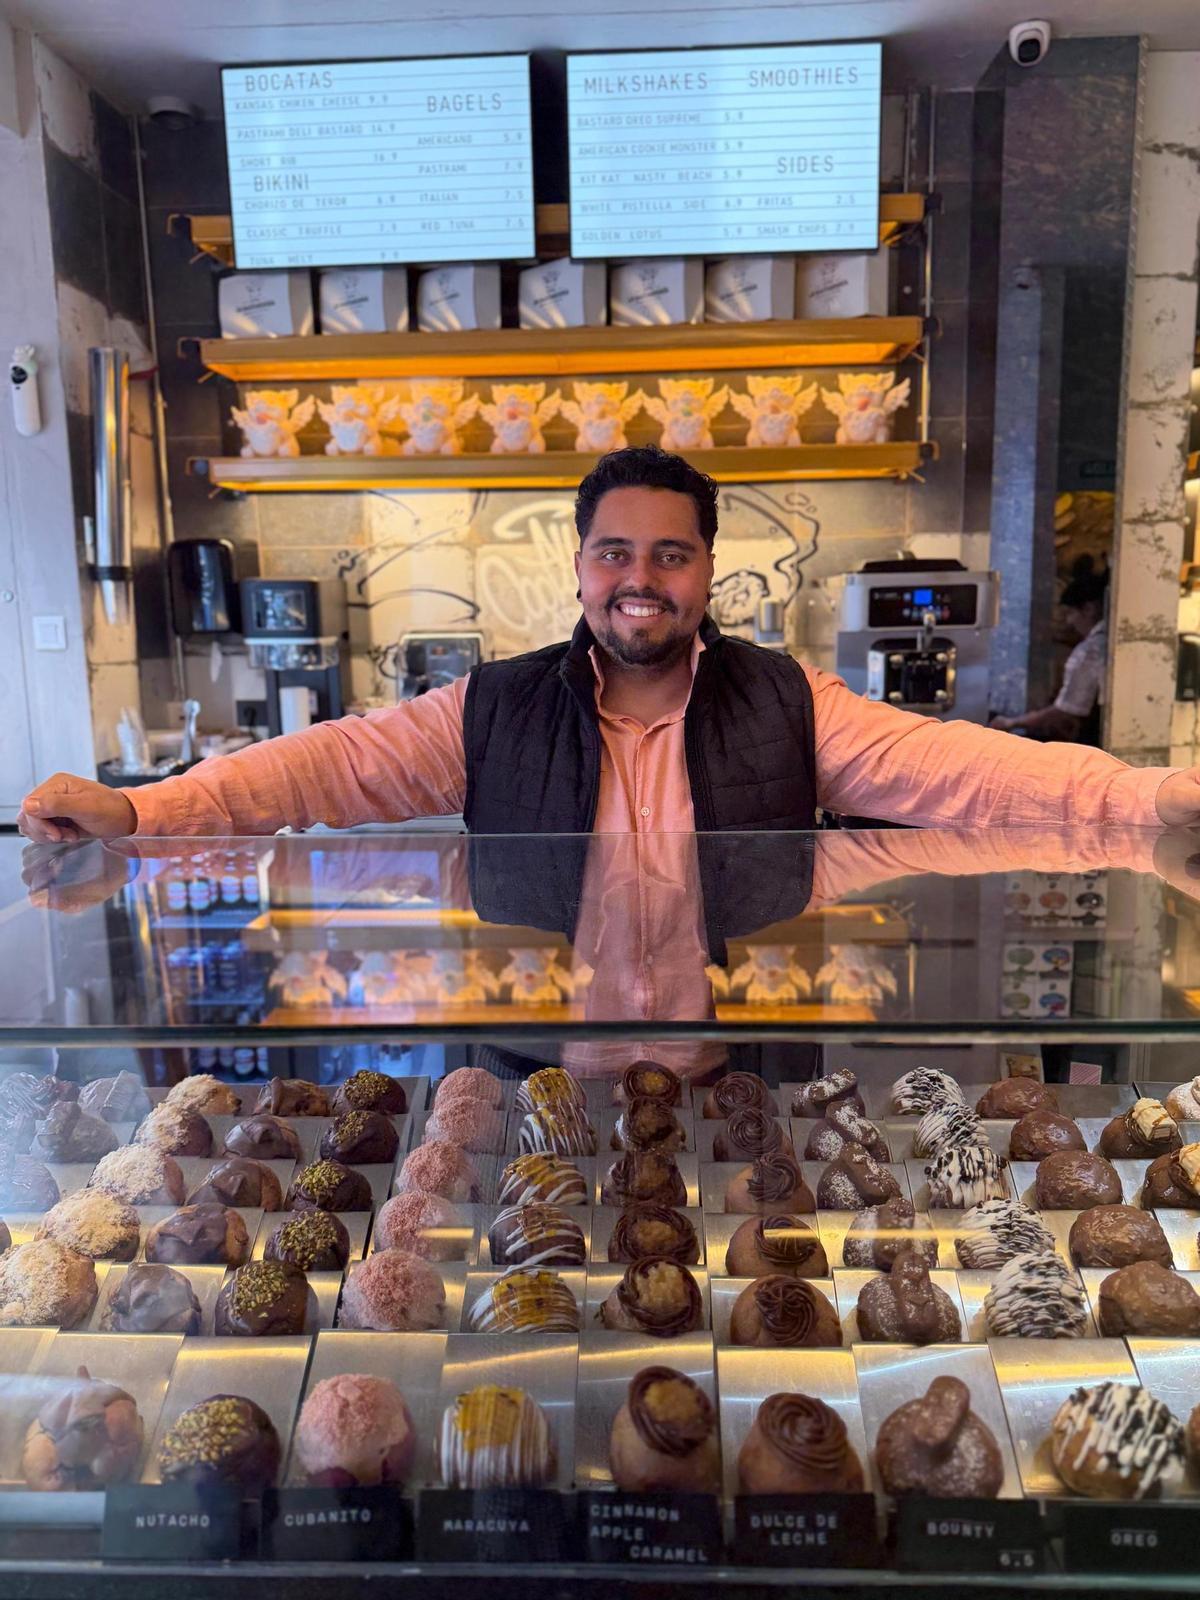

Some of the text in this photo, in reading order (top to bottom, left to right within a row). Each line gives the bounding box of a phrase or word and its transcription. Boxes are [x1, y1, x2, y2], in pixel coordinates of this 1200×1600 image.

[245, 71, 333, 92] BOCATAS
[584, 72, 708, 94] MILKSHAKES
[749, 66, 858, 87] SMOOTHIES
[235, 100, 274, 110] KANSAS
[322, 96, 360, 106] CHEESE
[427, 93, 502, 112] BAGELS
[577, 117, 623, 127] BASTARD
[626, 115, 652, 125] OREO
[656, 113, 701, 124] SUPREME
[238, 129, 285, 139] PASTRAMI
[289, 127, 312, 136] DELI
[318, 125, 363, 135] BASTARD
[418, 135, 472, 145] AMERICANO
[579, 144, 627, 155] AMERICAN
[631, 143, 665, 154] COOKIE
[670, 142, 716, 152] MONSTER
[240, 157, 271, 167] SHORT
[280, 156, 296, 165] RIB
[777, 155, 834, 174] SIDES
[418, 164, 467, 174] PASTRAMI
[254, 174, 309, 192] BIKINI
[580, 175, 596, 184] KIT
[602, 174, 620, 182] KAT
[634, 172, 665, 182] NASTY
[245, 200, 287, 210] CHORIZO
[293, 199, 304, 208] DE
[315, 197, 347, 207] TEROR
[420, 192, 458, 202] ITALIAN
[757, 197, 794, 206] FRITAS
[581, 203, 611, 212] WHITE
[246, 228, 287, 238] CLASSIC
[299, 225, 342, 235] TRUFFLE
[421, 221, 440, 231] RED
[450, 220, 474, 230] TUNA
[757, 225, 789, 236] SMASH
[798, 225, 827, 234] CHIPS
[582, 232, 620, 241] GOLDEN
[630, 230, 662, 240] LOTUS
[284, 1509, 372, 1527] CUBANITO
[590, 1504, 680, 1521] CINNAMON
[135, 1514, 210, 1529] NUTACHO
[443, 1519, 529, 1533] MARACUYA
[751, 1514, 838, 1529] DULCE DE
[590, 1526, 644, 1542] APPLE
[926, 1522, 996, 1538] BOUNTY
[770, 1532, 827, 1546] LECHE
[1110, 1533, 1158, 1546] OREO
[630, 1546, 708, 1562] CARAMEL
[1000, 1552, 1034, 1567] 6.5
